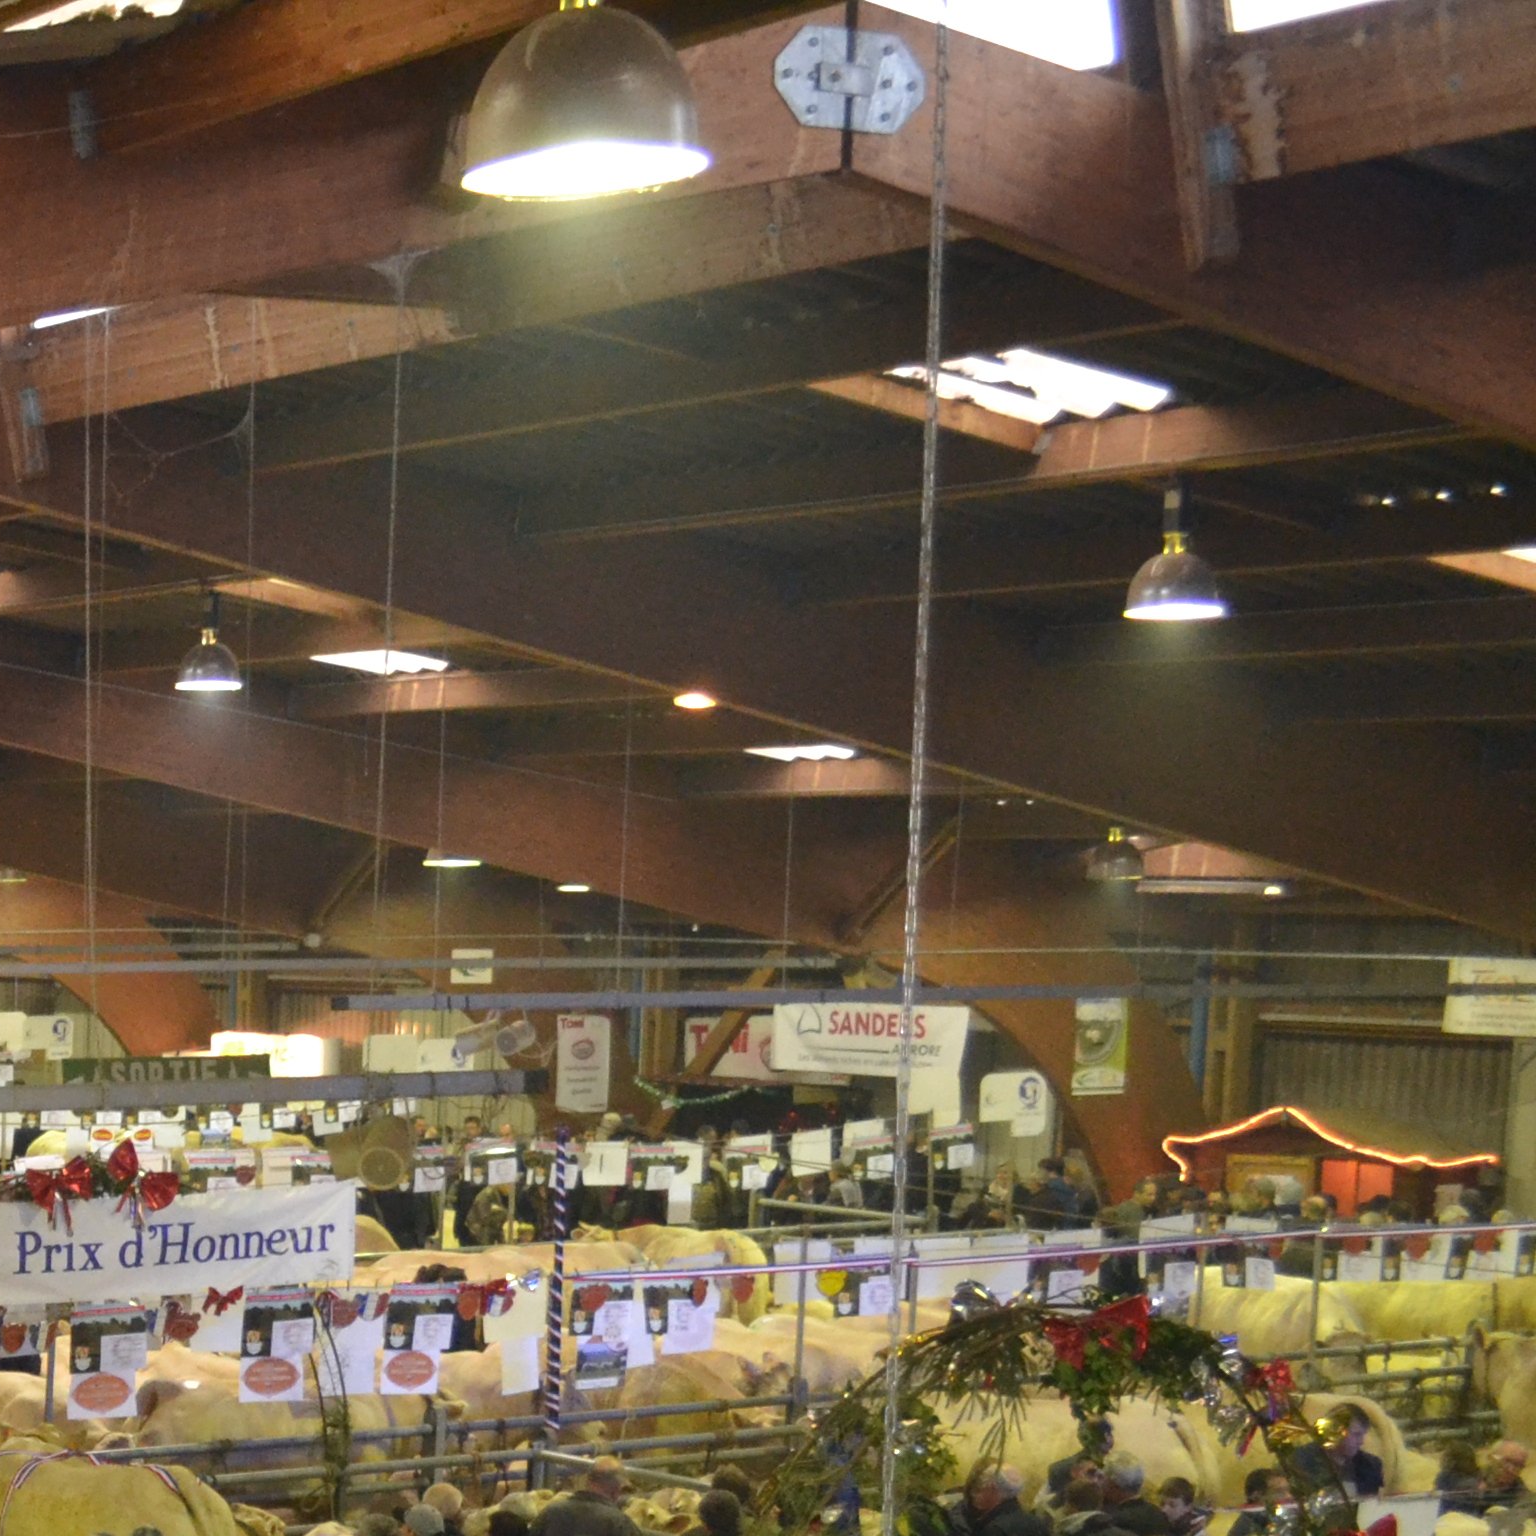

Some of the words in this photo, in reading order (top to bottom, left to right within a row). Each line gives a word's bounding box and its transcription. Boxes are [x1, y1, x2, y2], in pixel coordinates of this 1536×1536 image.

[892, 1044, 942, 1057] ARORE
[15, 1230, 104, 1275] Prix
[119, 1220, 336, 1269] d'Honneur
